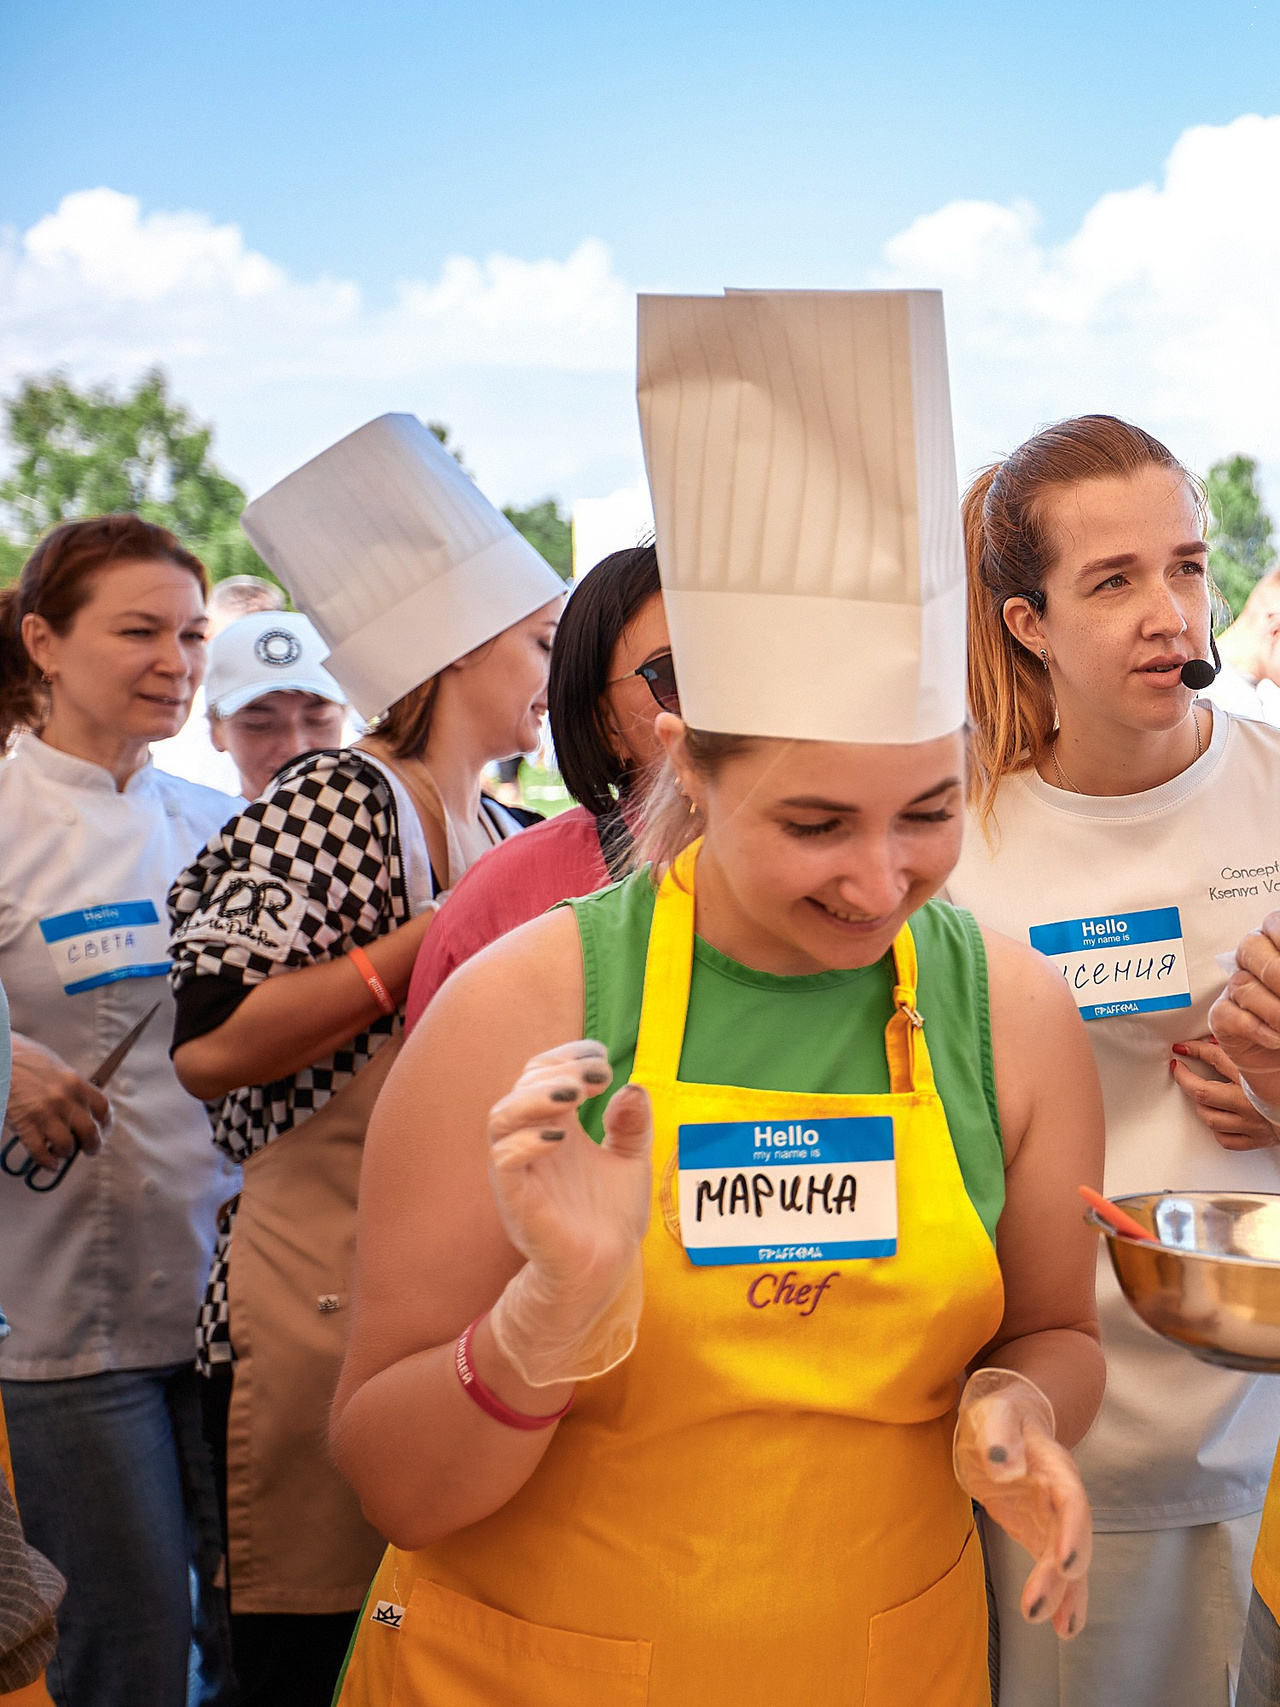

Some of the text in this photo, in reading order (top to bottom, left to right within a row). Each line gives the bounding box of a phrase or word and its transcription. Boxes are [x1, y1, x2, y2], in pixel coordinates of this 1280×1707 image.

[1220, 860, 1280, 880] Concept
[1208, 885, 1259, 901] Kseniya
[1081, 918, 1128, 937] Hello
[67, 931, 135, 964] СВЕТА
[1083, 933, 1131, 947] my name is
[1063, 953, 1176, 989] сения
[753, 1124, 820, 1148] Hello
[752, 1147, 822, 1163] my name is
[695, 1172, 857, 1223] МАРИНА
[746, 1269, 841, 1317] Chef
